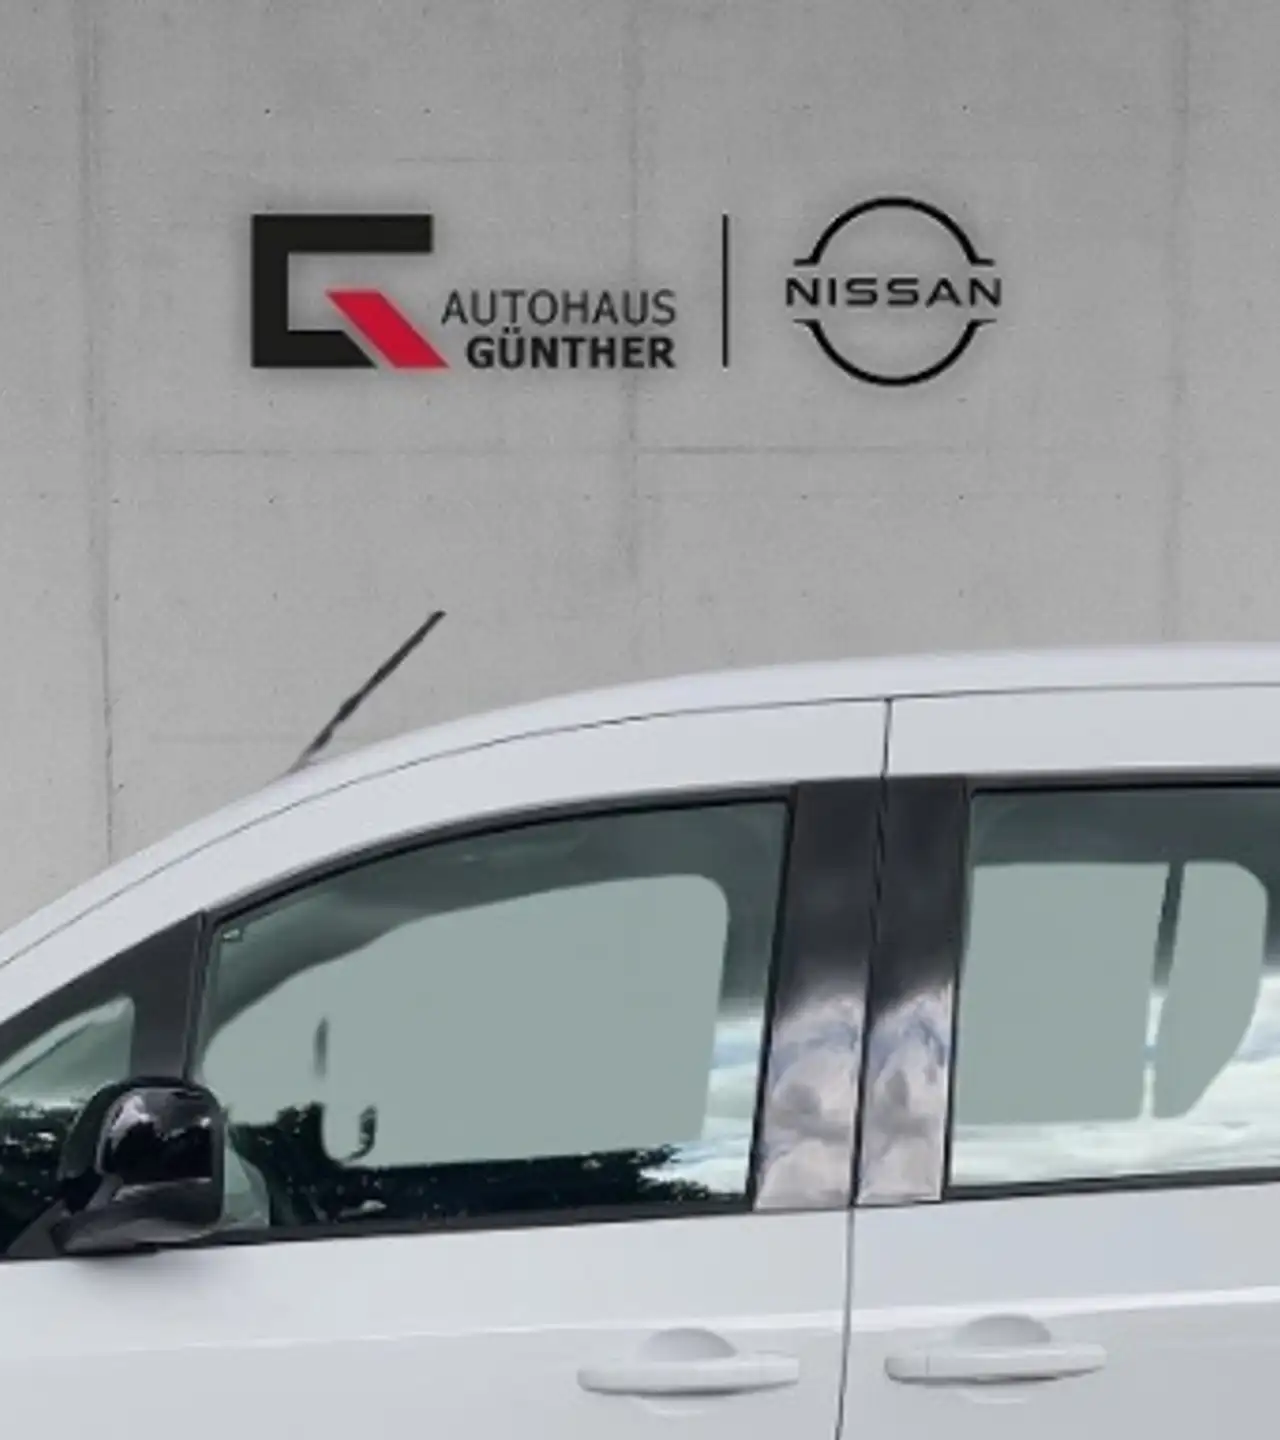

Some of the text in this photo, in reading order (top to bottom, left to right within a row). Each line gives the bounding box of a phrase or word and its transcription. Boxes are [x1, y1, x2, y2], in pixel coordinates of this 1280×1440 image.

[441, 288, 677, 326] AUTOHAUS
[785, 277, 1002, 307] NISSAN
[465, 328, 677, 370] GÜNTHER
